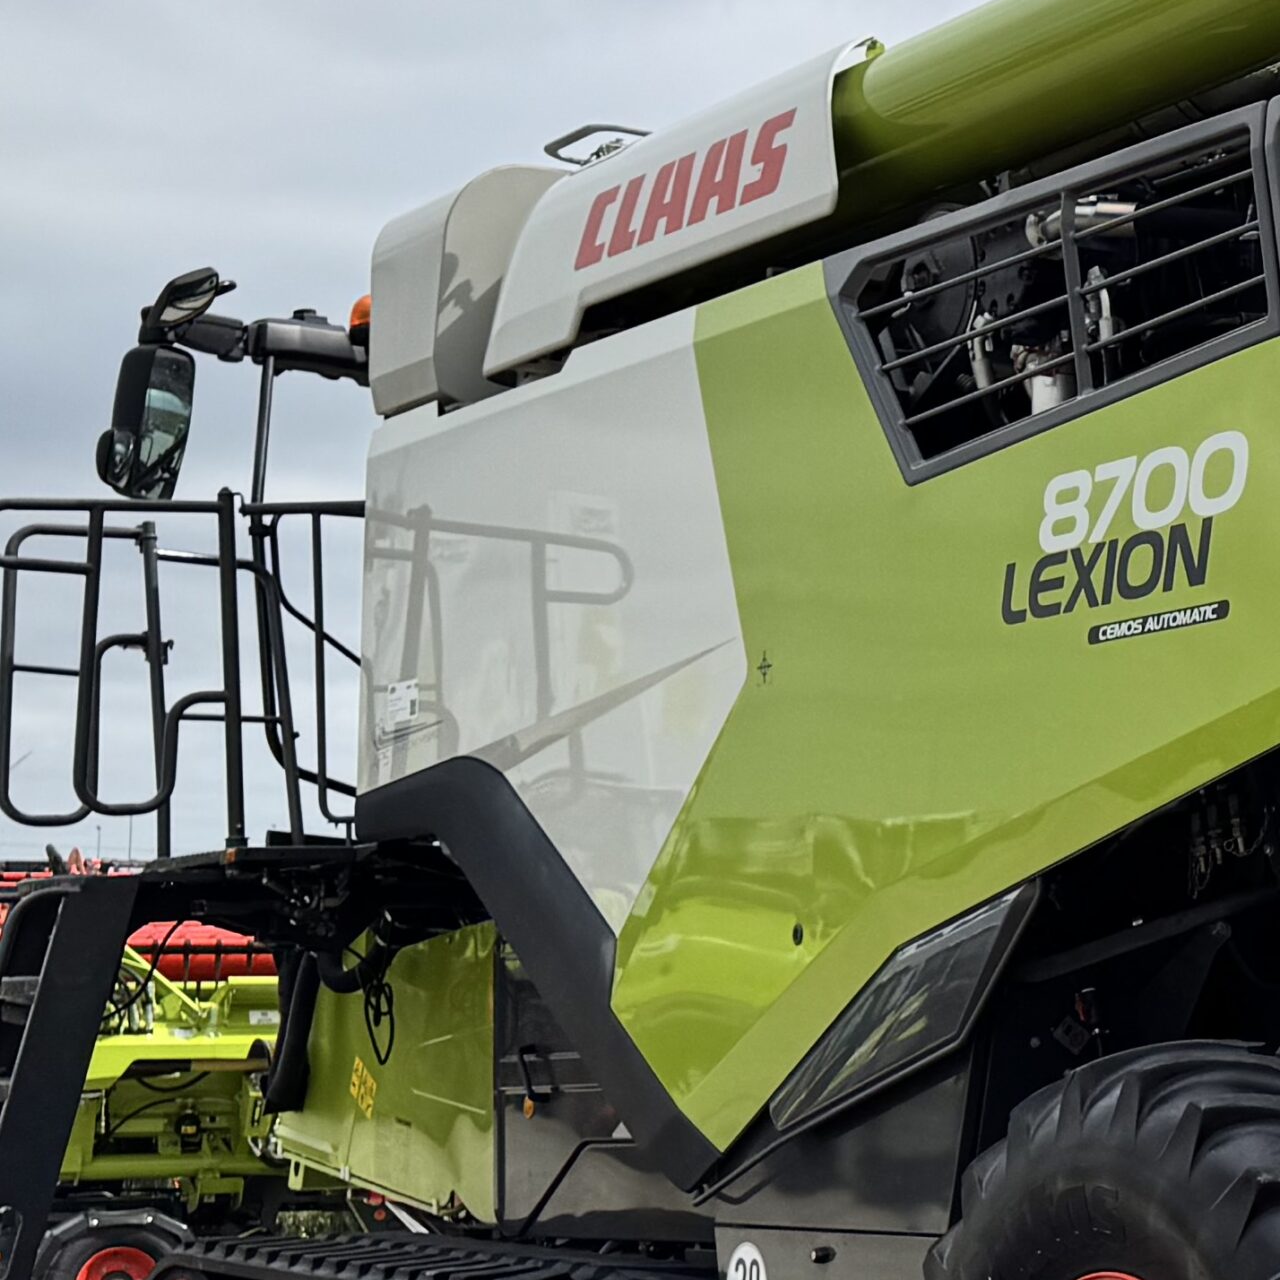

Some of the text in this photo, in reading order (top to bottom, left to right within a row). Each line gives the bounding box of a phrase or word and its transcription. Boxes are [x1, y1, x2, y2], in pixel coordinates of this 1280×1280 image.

[574, 107, 798, 271] CLAAS
[1039, 430, 1249, 554] 8700
[1002, 516, 1213, 625] LEXION
[1098, 604, 1219, 641] CEMOS AUTOMATIC
